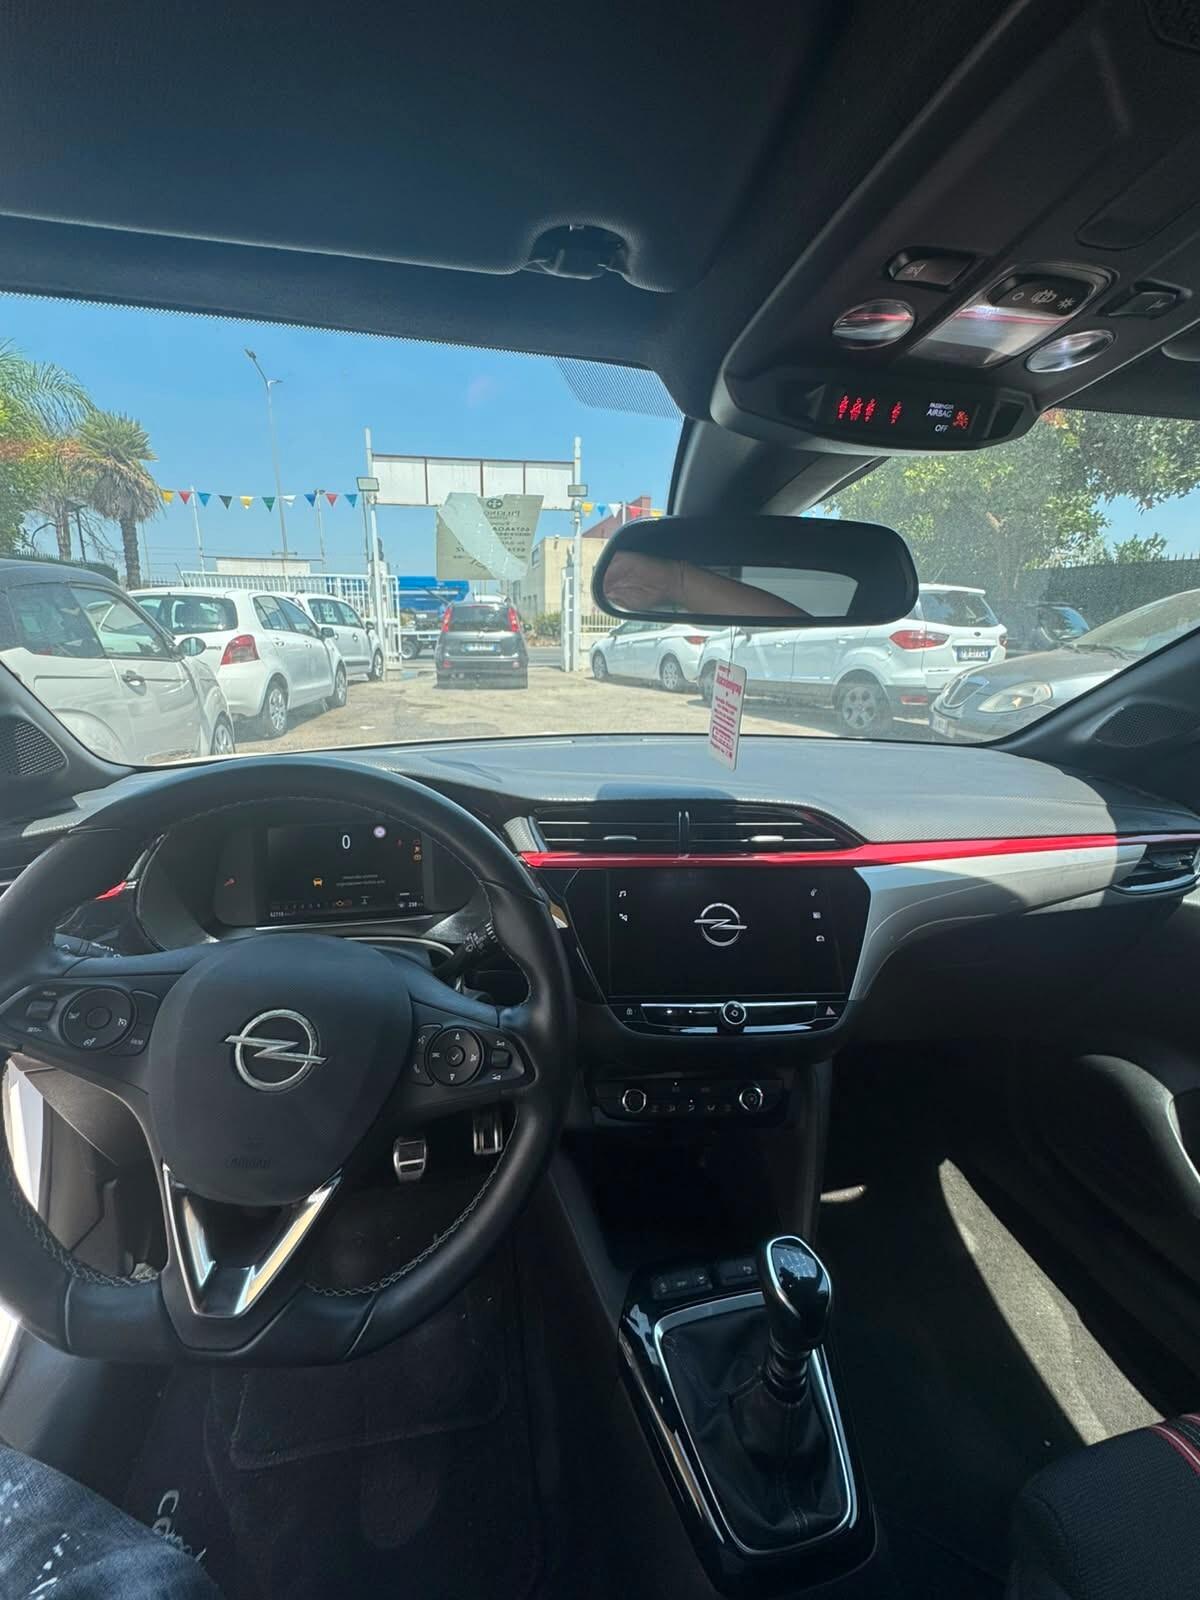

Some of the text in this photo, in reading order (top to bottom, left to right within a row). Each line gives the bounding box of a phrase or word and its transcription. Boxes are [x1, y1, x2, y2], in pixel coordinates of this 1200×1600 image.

[926, 408, 953, 418] AIRBAG
[934, 424, 949, 432] OFF
[342, 834, 351, 849] 0
